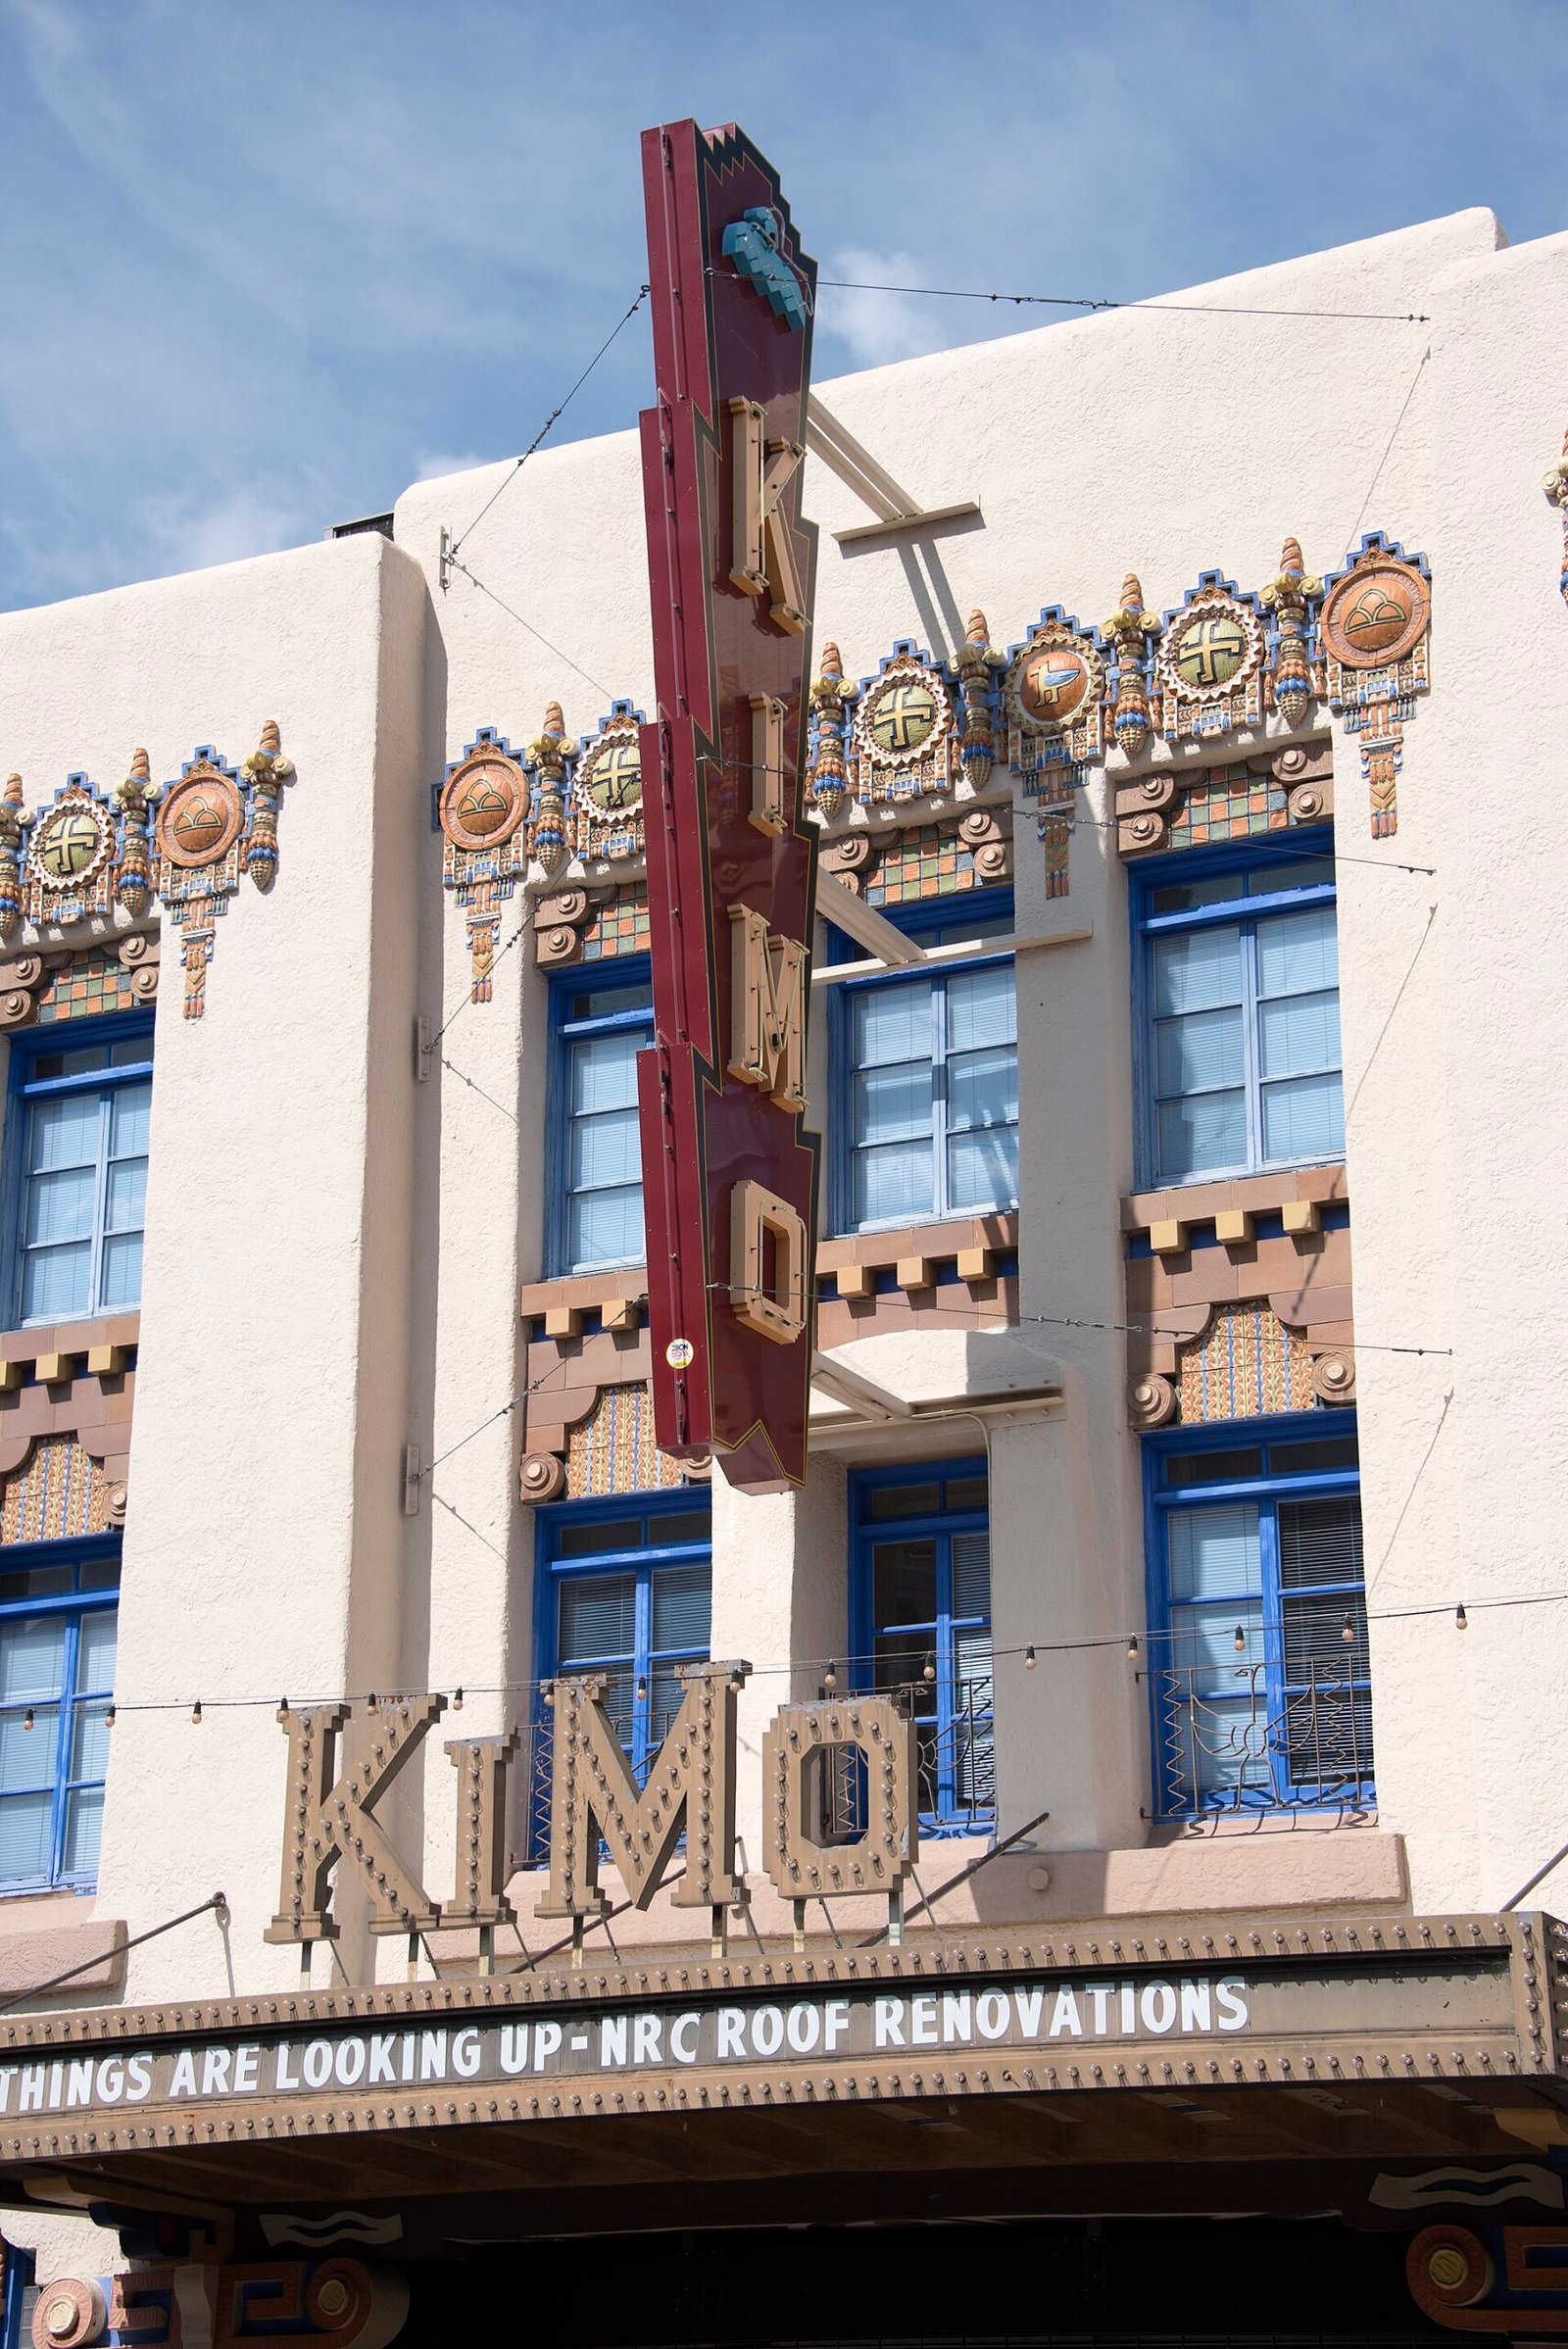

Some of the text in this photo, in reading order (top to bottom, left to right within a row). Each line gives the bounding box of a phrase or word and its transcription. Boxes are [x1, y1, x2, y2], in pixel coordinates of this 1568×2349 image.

[0, 2050, 153, 2112] THINGS
[169, 2042, 261, 2097] ARE
[274, 2026, 481, 2090] LOOKING
[716, 2000, 850, 2058] ROOF
[875, 1976, 1249, 2047] RENOVATIONS
